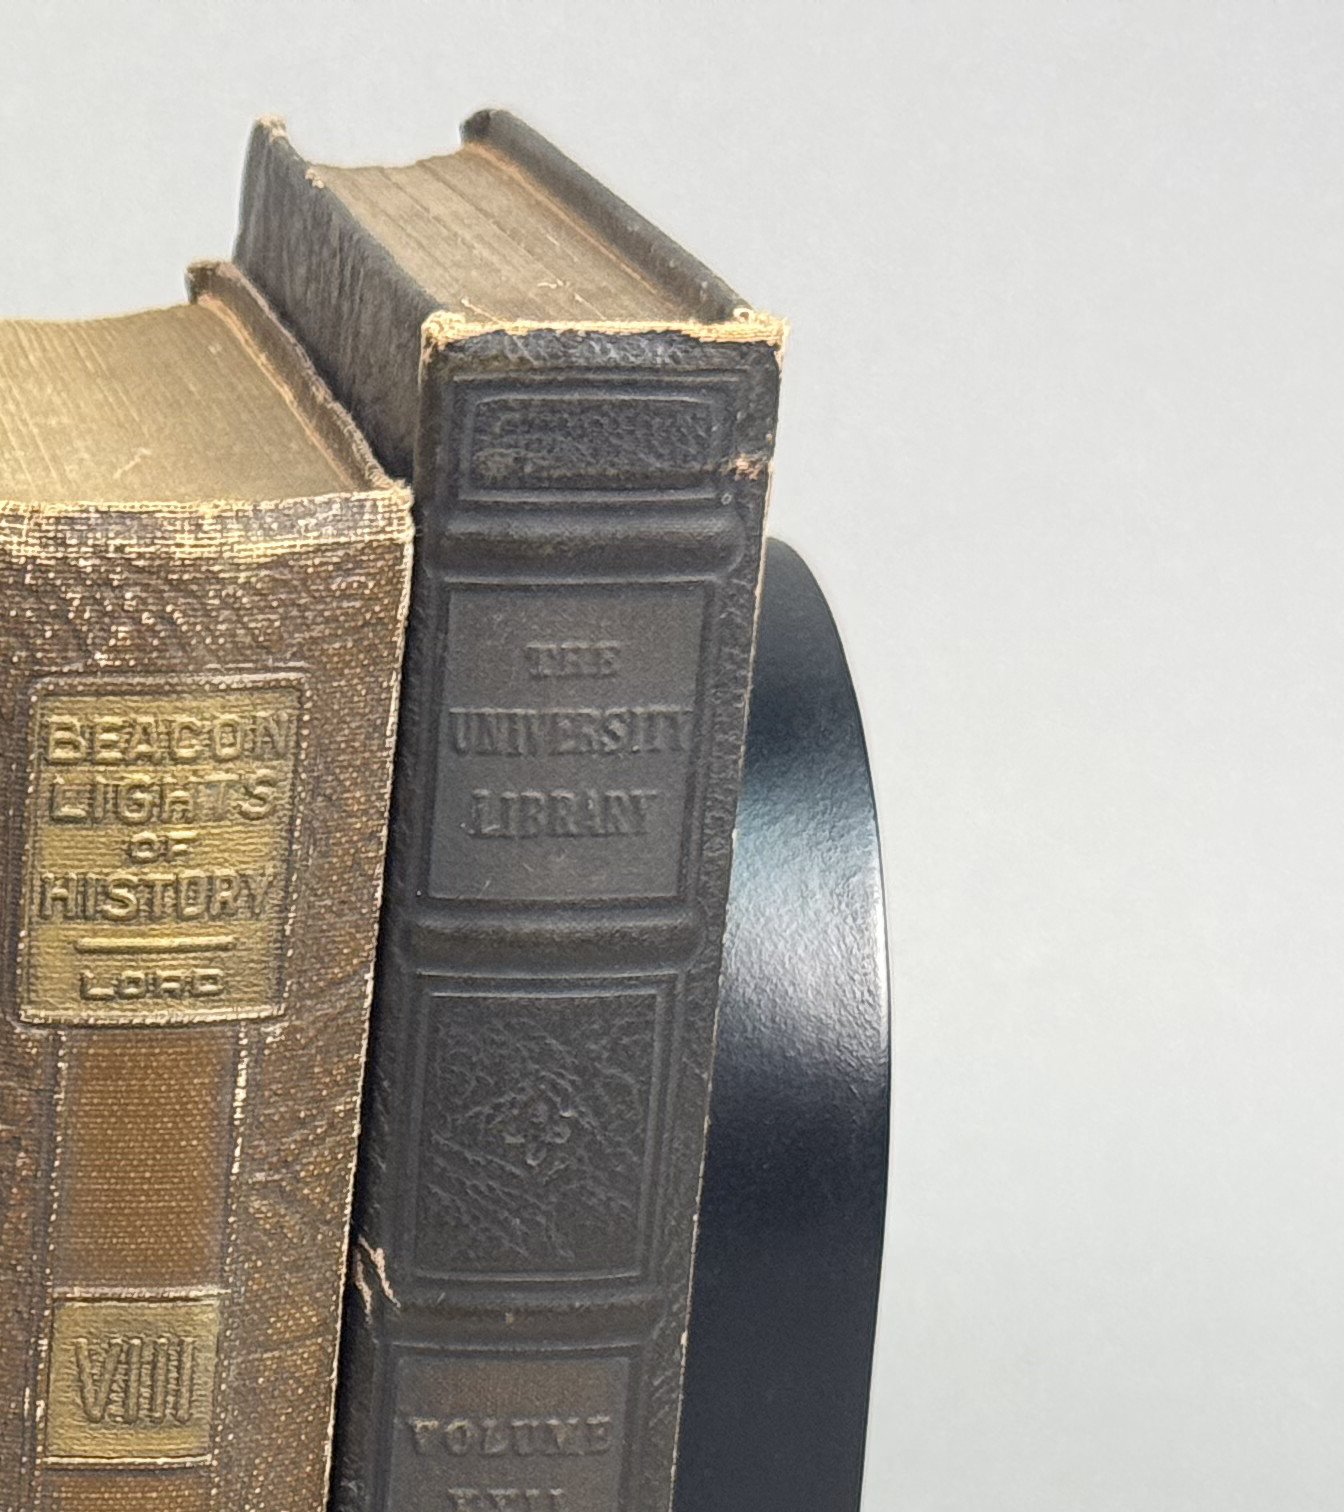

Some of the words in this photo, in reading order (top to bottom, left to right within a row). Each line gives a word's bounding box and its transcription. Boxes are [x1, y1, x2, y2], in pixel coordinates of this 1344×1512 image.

[524, 640, 620, 679] THE
[42, 715, 293, 764] BEACON
[448, 705, 694, 757] UNIVERSITY
[49, 771, 278, 825] LIGHTS
[470, 787, 658, 839] LIBRARY
[125, 830, 198, 863] OF
[39, 871, 276, 923] HISTORY
[80, 968, 225, 1002] LORD
[75, 1336, 196, 1424] VIII
[410, 1415, 612, 1456] VOLUME
